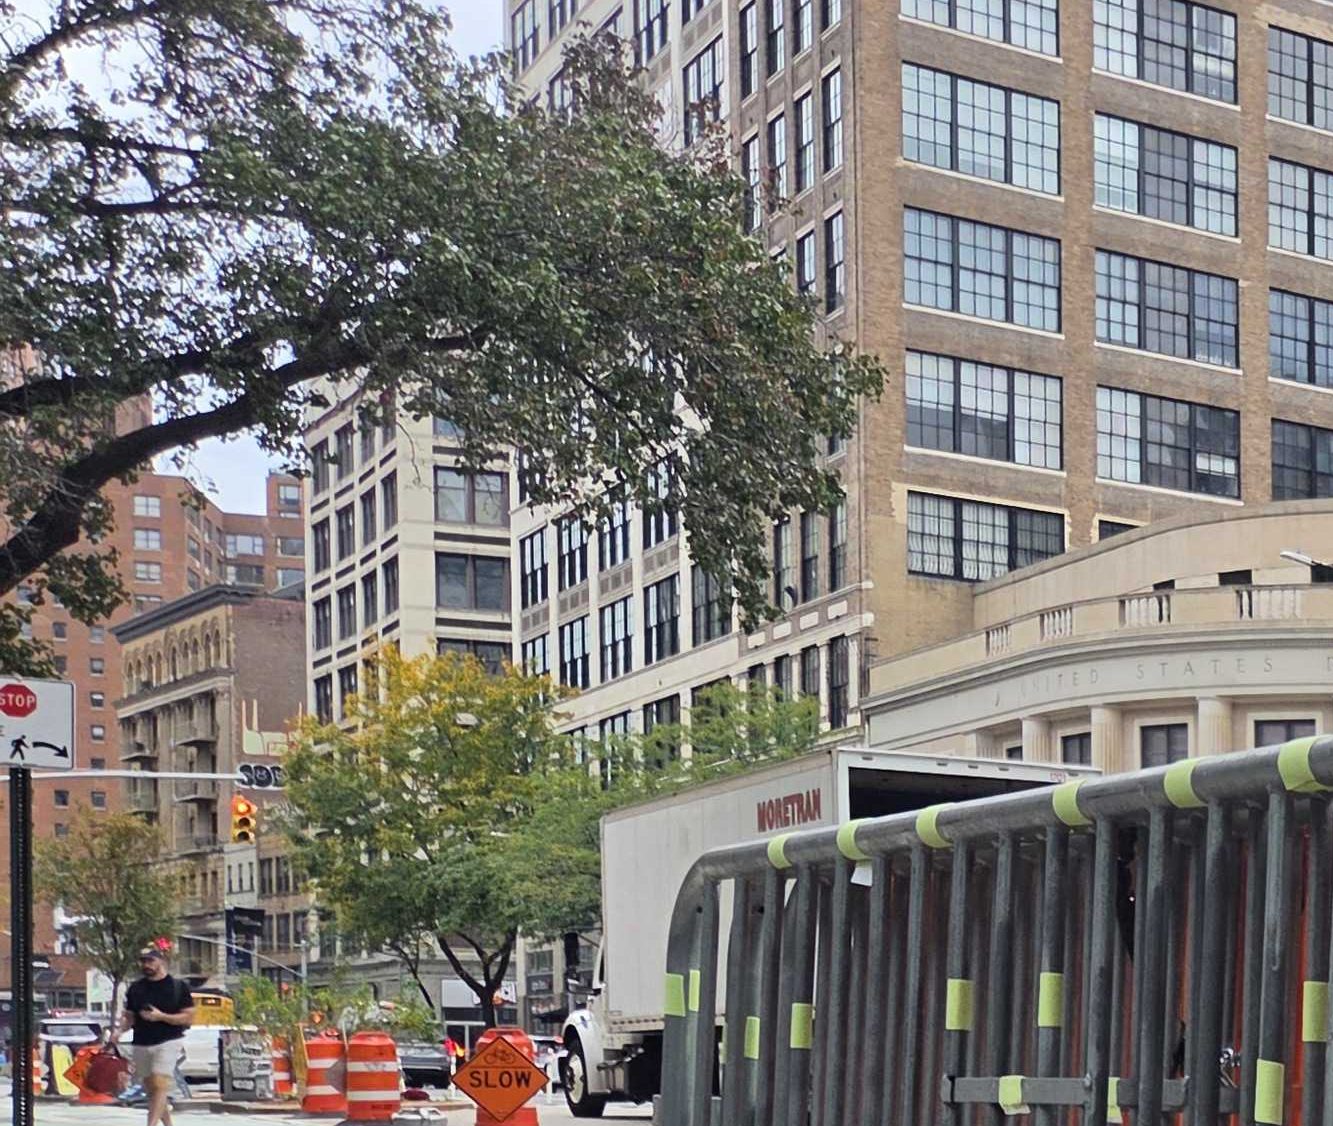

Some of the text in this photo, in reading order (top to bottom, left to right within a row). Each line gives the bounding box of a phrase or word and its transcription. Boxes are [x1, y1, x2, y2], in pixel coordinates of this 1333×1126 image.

[1136, 655, 1273, 680] STATES
[0, 692, 36, 709] STOP
[469, 1070, 531, 1089] SLOW
